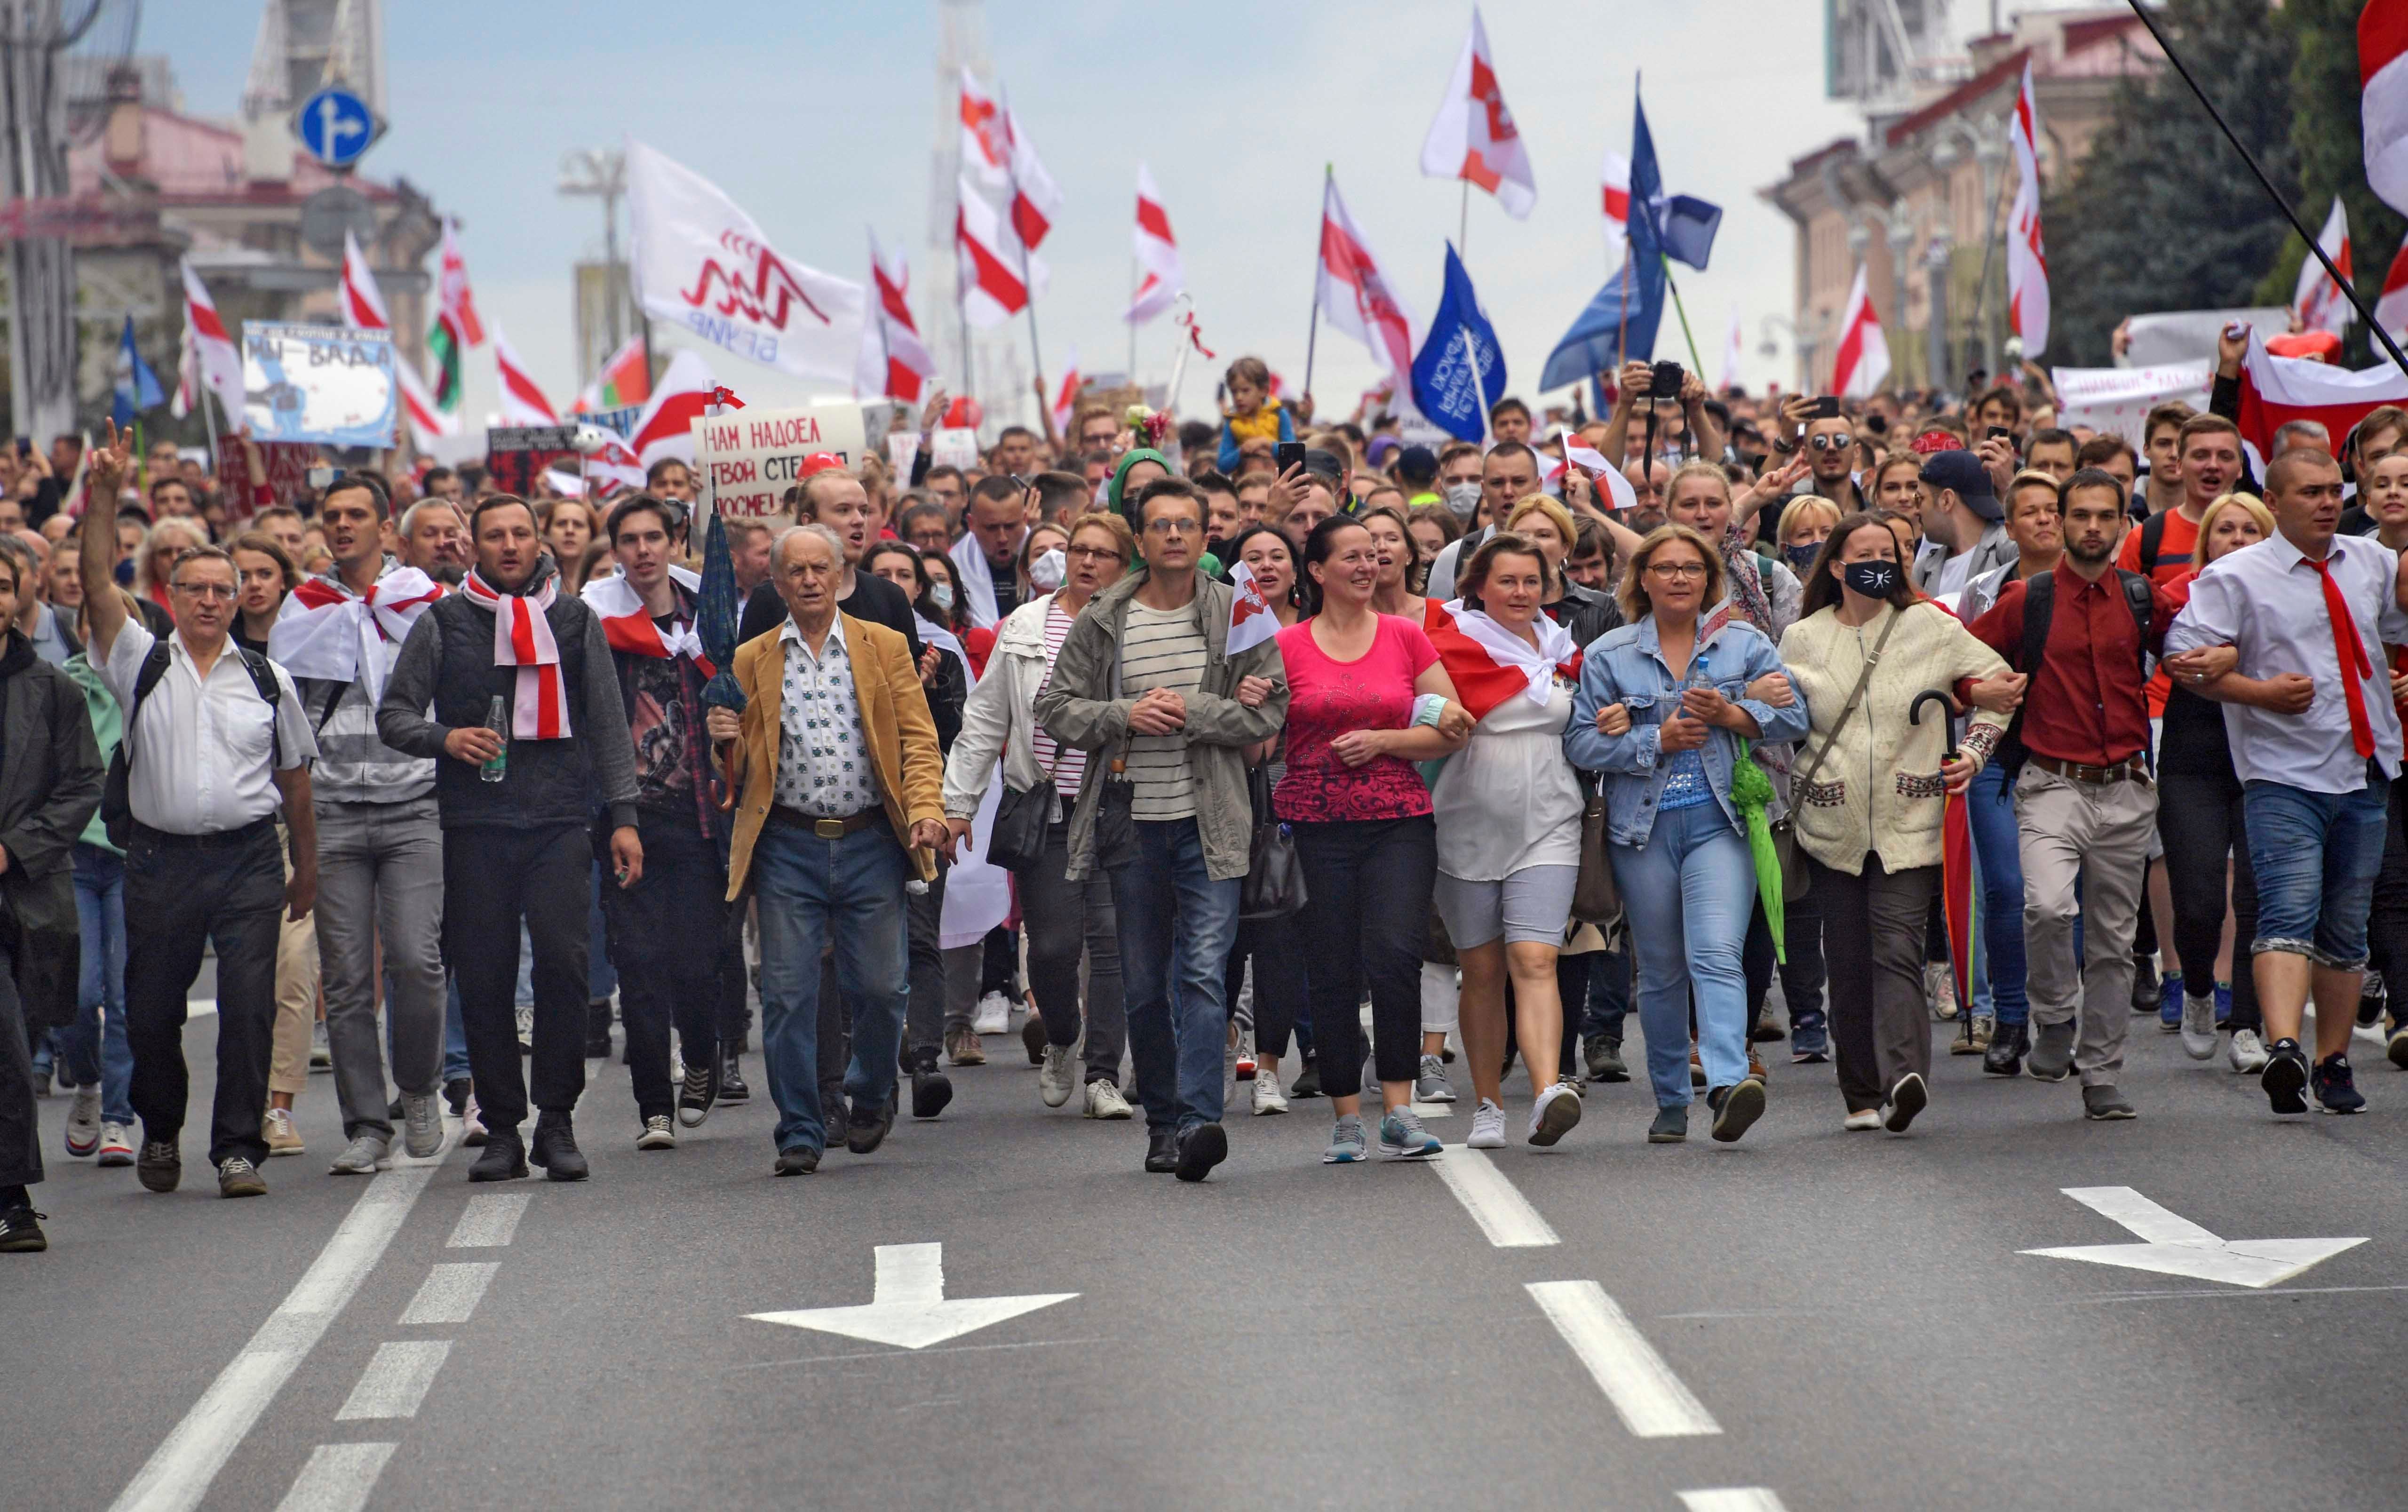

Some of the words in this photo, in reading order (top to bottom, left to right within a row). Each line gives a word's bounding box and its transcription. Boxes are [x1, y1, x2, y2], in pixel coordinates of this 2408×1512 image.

[309, 342, 390, 368] ВАДА
[704, 424, 741, 452] НАМ
[750, 417, 822, 450] НАДОЕЛ
[707, 458, 757, 485] ТВОЙ
